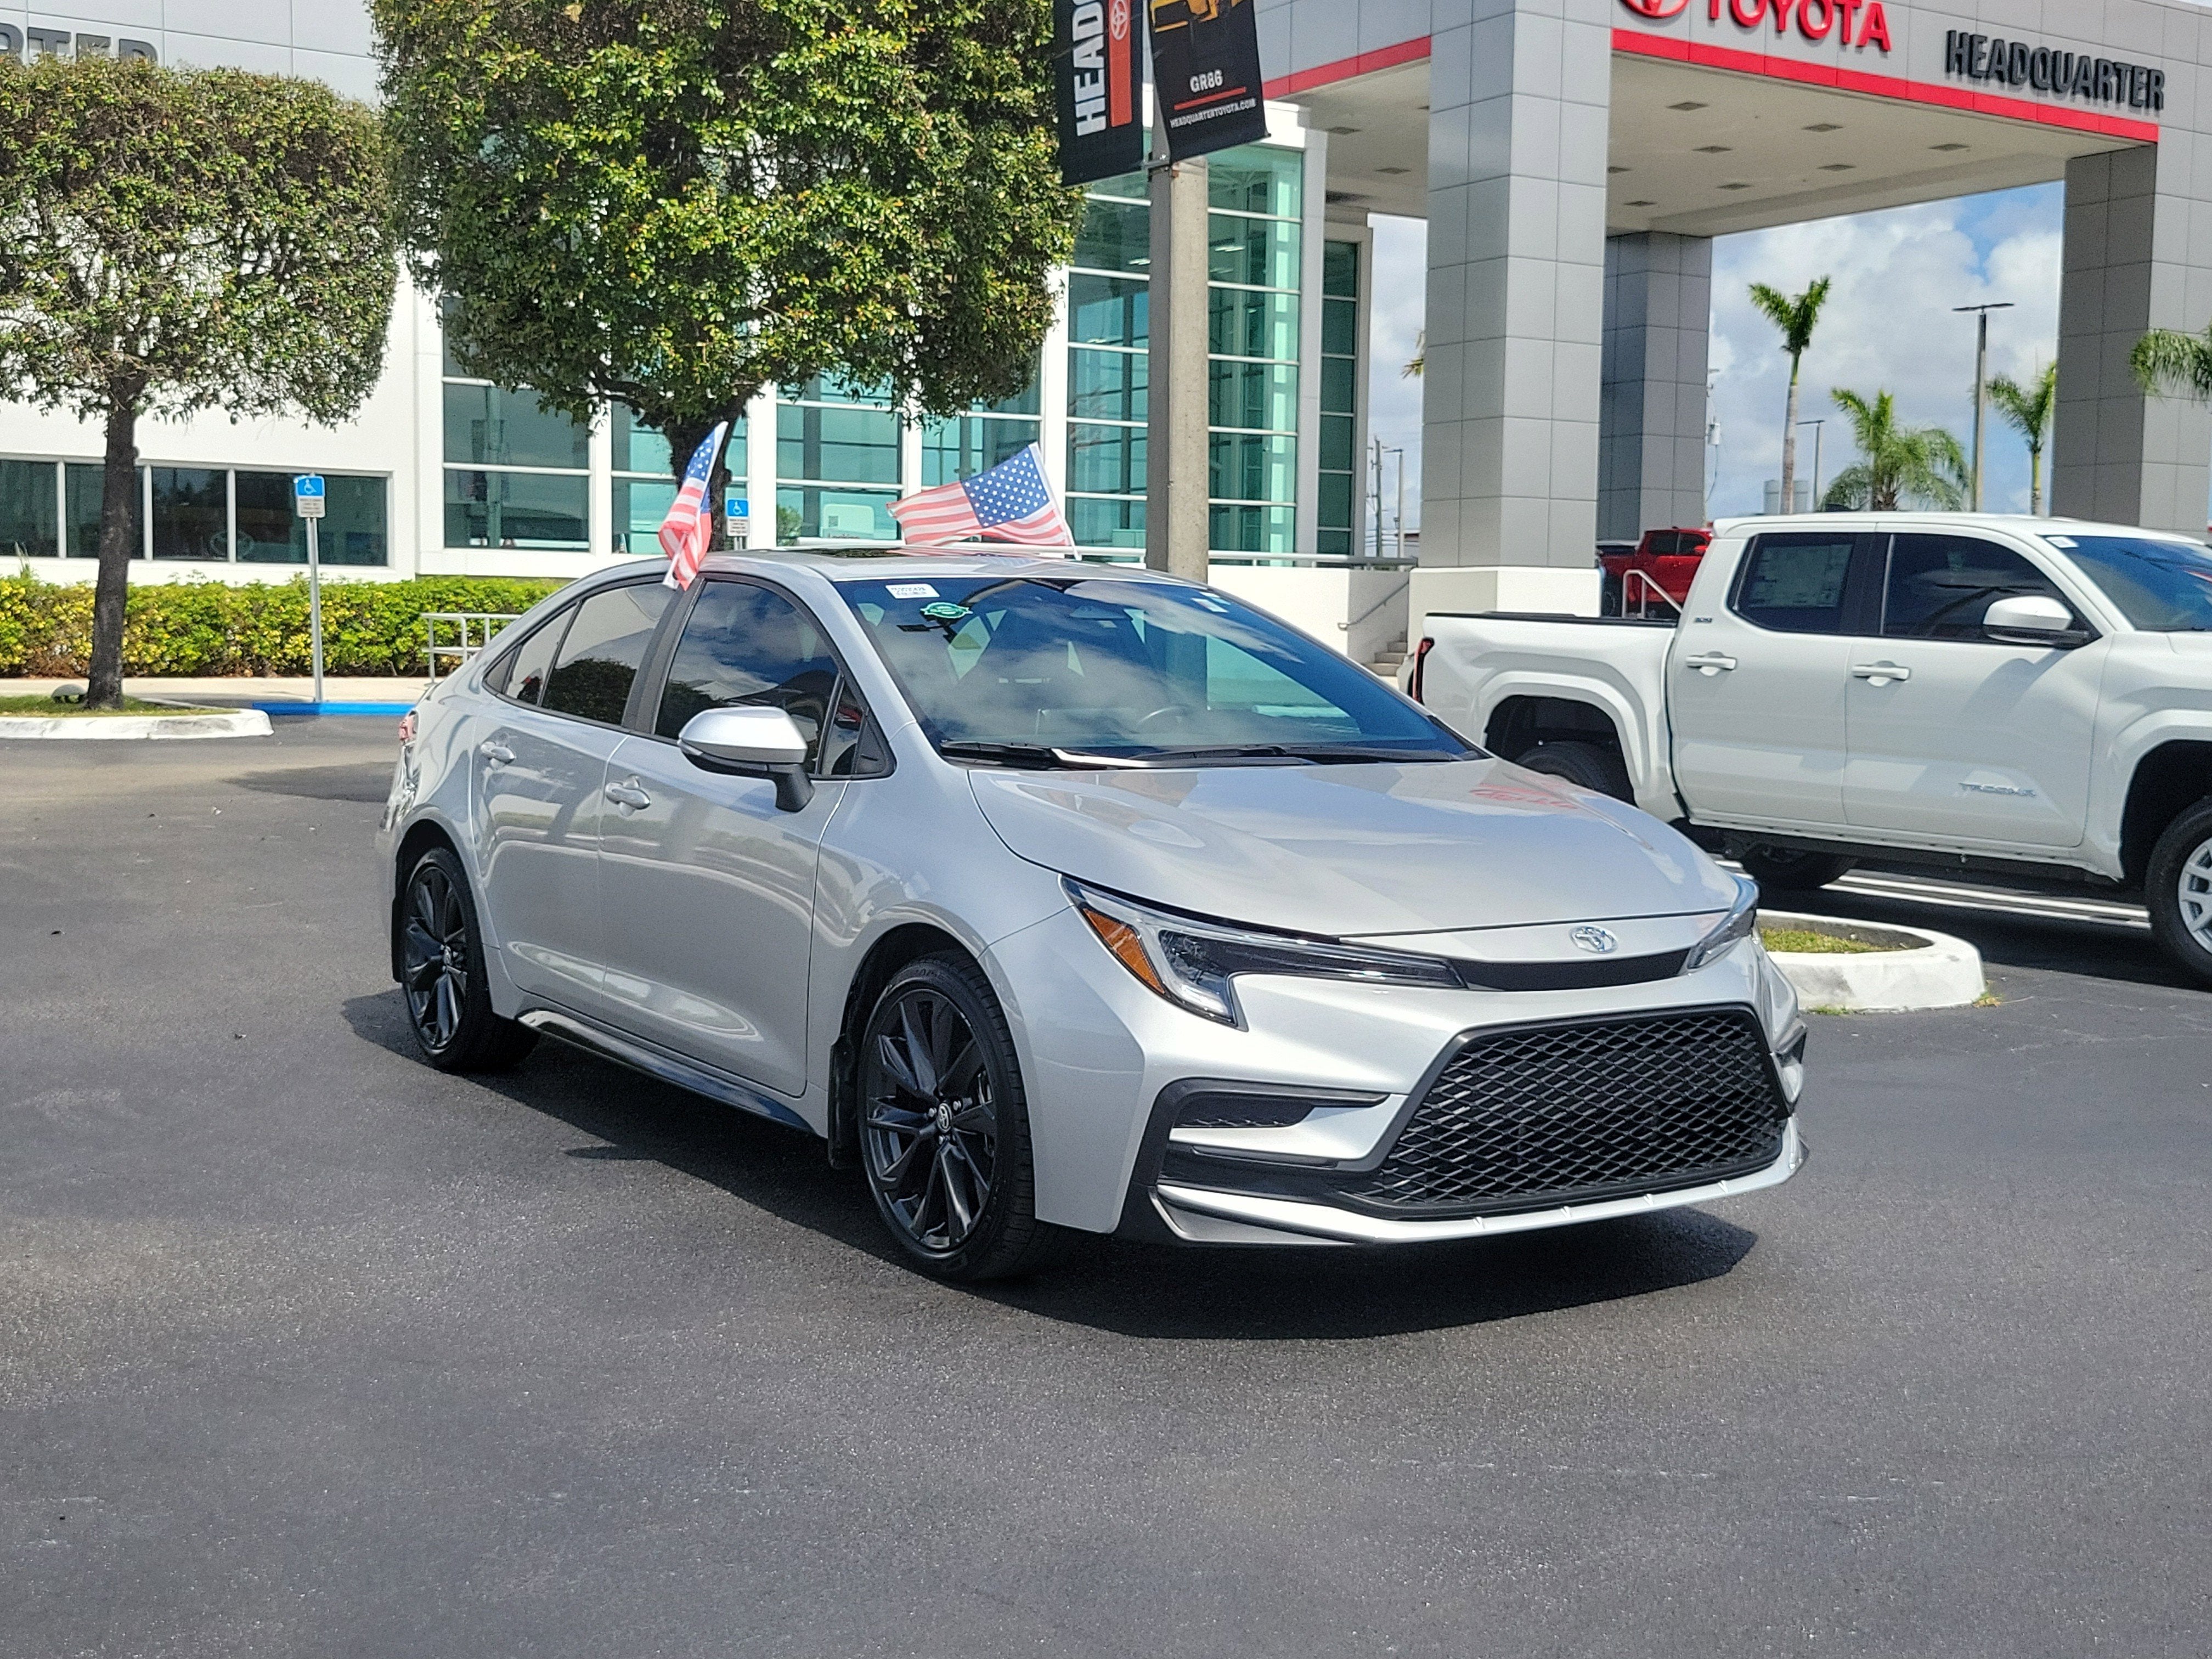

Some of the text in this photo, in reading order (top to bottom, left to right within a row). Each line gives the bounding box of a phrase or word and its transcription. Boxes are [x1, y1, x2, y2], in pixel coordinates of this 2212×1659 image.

[1073, 0, 1107, 137] HEAD
[1189, 69, 1224, 93] GR86
[1945, 30, 2165, 110] HEADQUARTER
